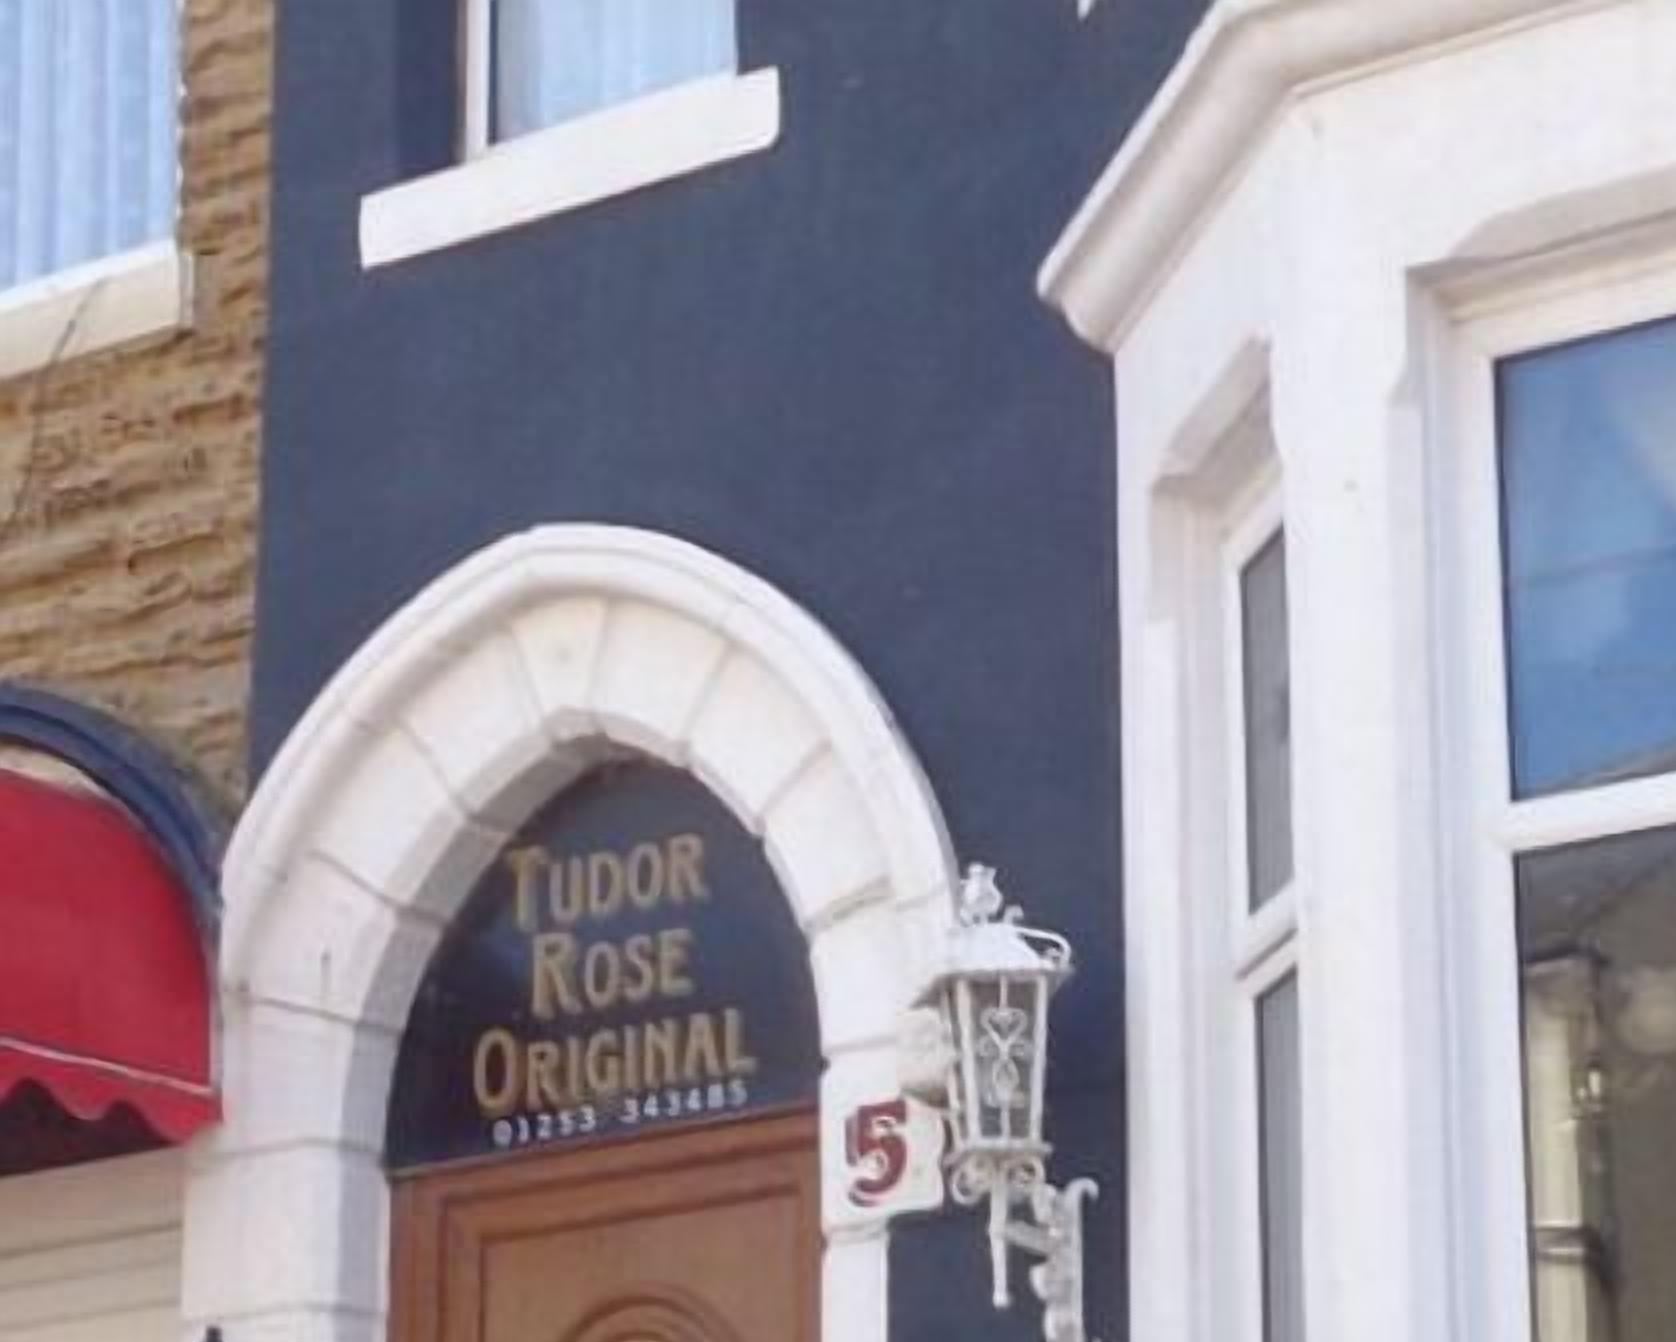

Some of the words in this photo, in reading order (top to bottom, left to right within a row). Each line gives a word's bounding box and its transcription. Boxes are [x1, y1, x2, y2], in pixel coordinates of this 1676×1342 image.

[507, 833, 708, 930] TUDOR
[533, 929, 695, 1019] ROSE
[472, 1009, 756, 1117] ORIGINAL
[492, 1105, 597, 1148] 01253
[845, 1100, 907, 1207] 5
